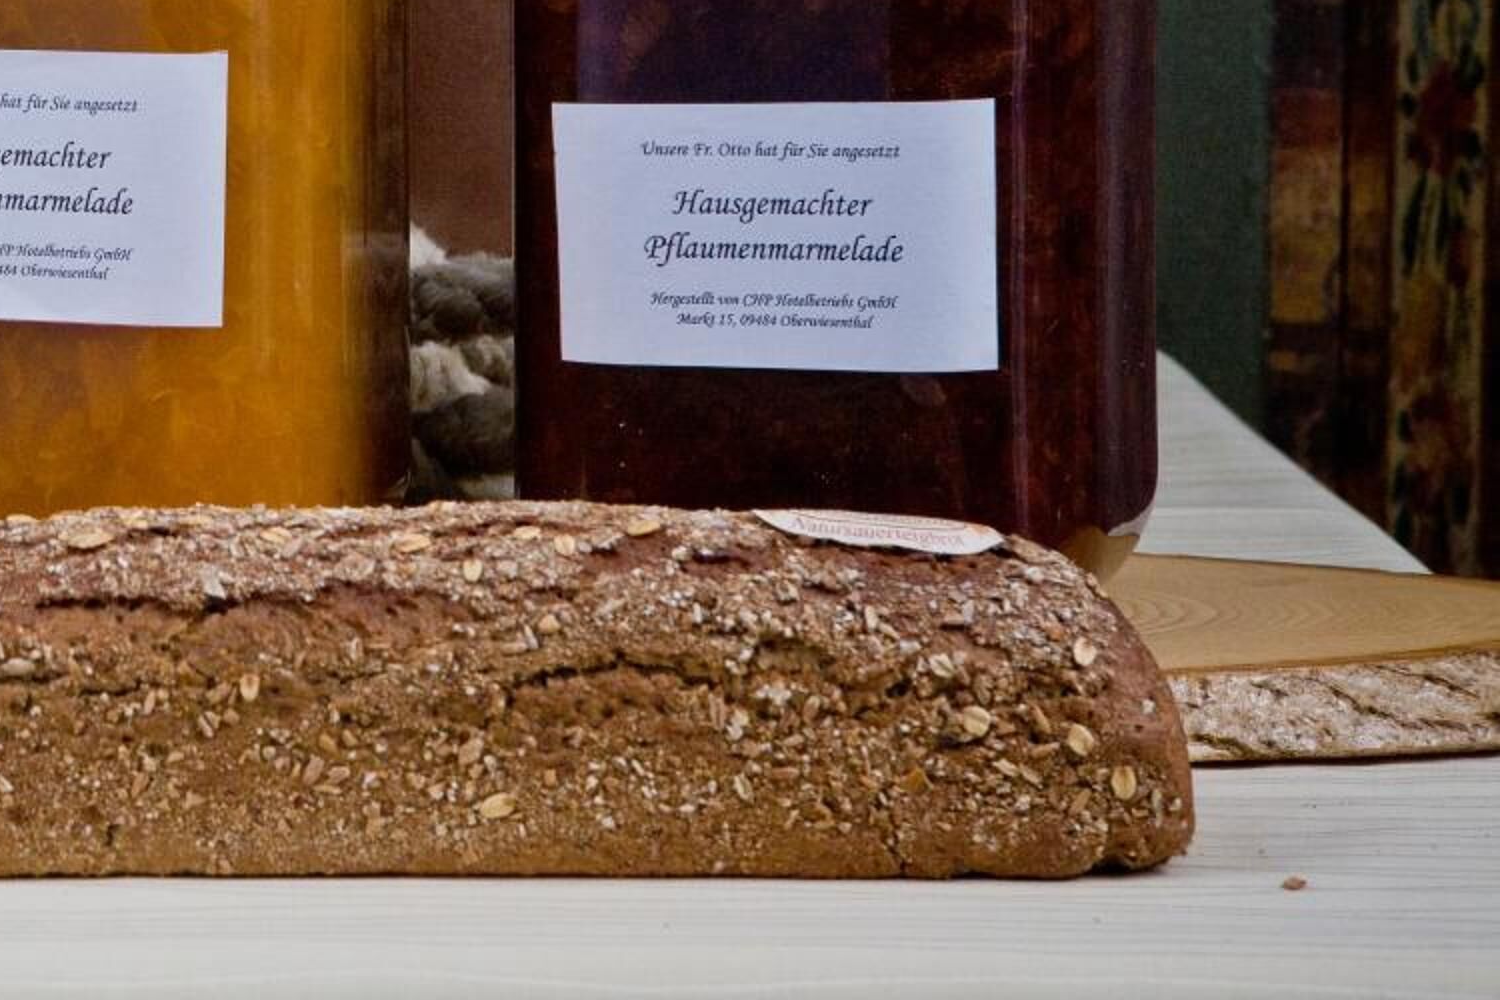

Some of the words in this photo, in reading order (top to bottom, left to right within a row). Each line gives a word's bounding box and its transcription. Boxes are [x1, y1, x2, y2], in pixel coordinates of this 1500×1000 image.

[0, 94, 22, 108] hat
[25, 94, 48, 113] für
[50, 96, 70, 110] Sie
[74, 100, 137, 115] angesetzt
[641, 141, 689, 156] Unsere
[694, 143, 712, 156] Fr.
[718, 143, 751, 156] Otto
[755, 141, 777, 156] hat
[780, 141, 806, 161] für
[807, 143, 828, 158] Sie
[832, 146, 900, 162] angesetzt
[672, 188, 873, 224] Hausgemachter
[644, 232, 903, 267] Pflaumenmarmelade
[20, 263, 109, 280] Oberwiesenthal
[677, 312, 715, 328] Markt
[719, 314, 736, 327] 15,
[740, 314, 777, 326] 09484
[780, 314, 874, 328] Oberwiesenthal
